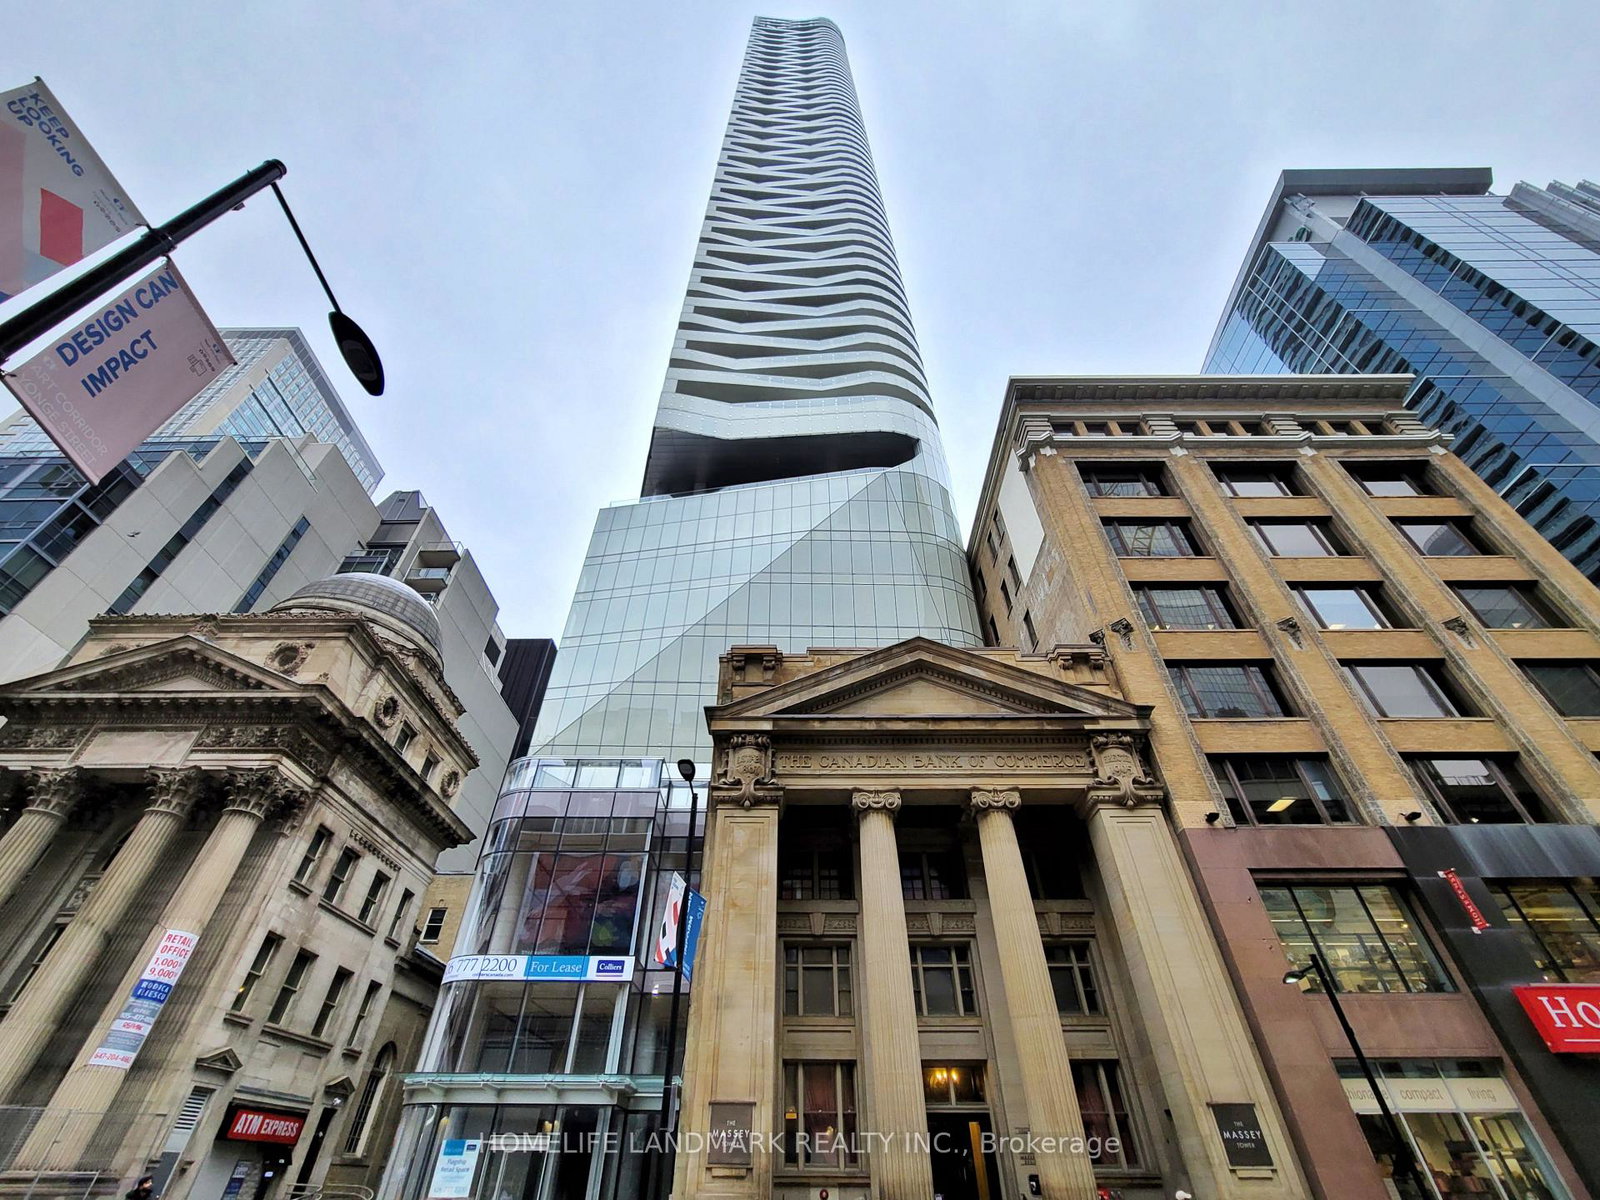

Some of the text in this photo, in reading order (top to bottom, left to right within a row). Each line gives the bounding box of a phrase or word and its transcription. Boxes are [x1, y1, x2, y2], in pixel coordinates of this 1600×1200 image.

[7, 100, 34, 127] UP
[29, 92, 70, 139] KEEP
[17, 96, 85, 177] LOOKING
[55, 298, 139, 368] DESIGN
[135, 271, 180, 309] CAN
[80, 329, 158, 398] IMPACT
[19, 372, 97, 466] YONGE STREET
[31, 365, 109, 457] ART CORRIDOR
[778, 754, 812, 769] THE
[818, 754, 907, 769] CANADIAN
[912, 754, 963, 769] BANK
[968, 755, 988, 768] OF
[994, 754, 1086, 768] COMMERCE
[160, 944, 190, 959] OFFICE
[165, 933, 192, 948] RETAIL
[456, 957, 479, 973] 777
[481, 957, 518, 973] 2200
[530, 961, 551, 973] For
[551, 961, 582, 973] Lease
[599, 962, 623, 971] Colliers
[1400, 1087, 1444, 1103] compact
[1467, 1087, 1497, 1103] living
[233, 1113, 299, 1137] ATM EXPRESS
[712, 1129, 750, 1138] MASSEY
[1222, 1130, 1261, 1139] MASSEY
